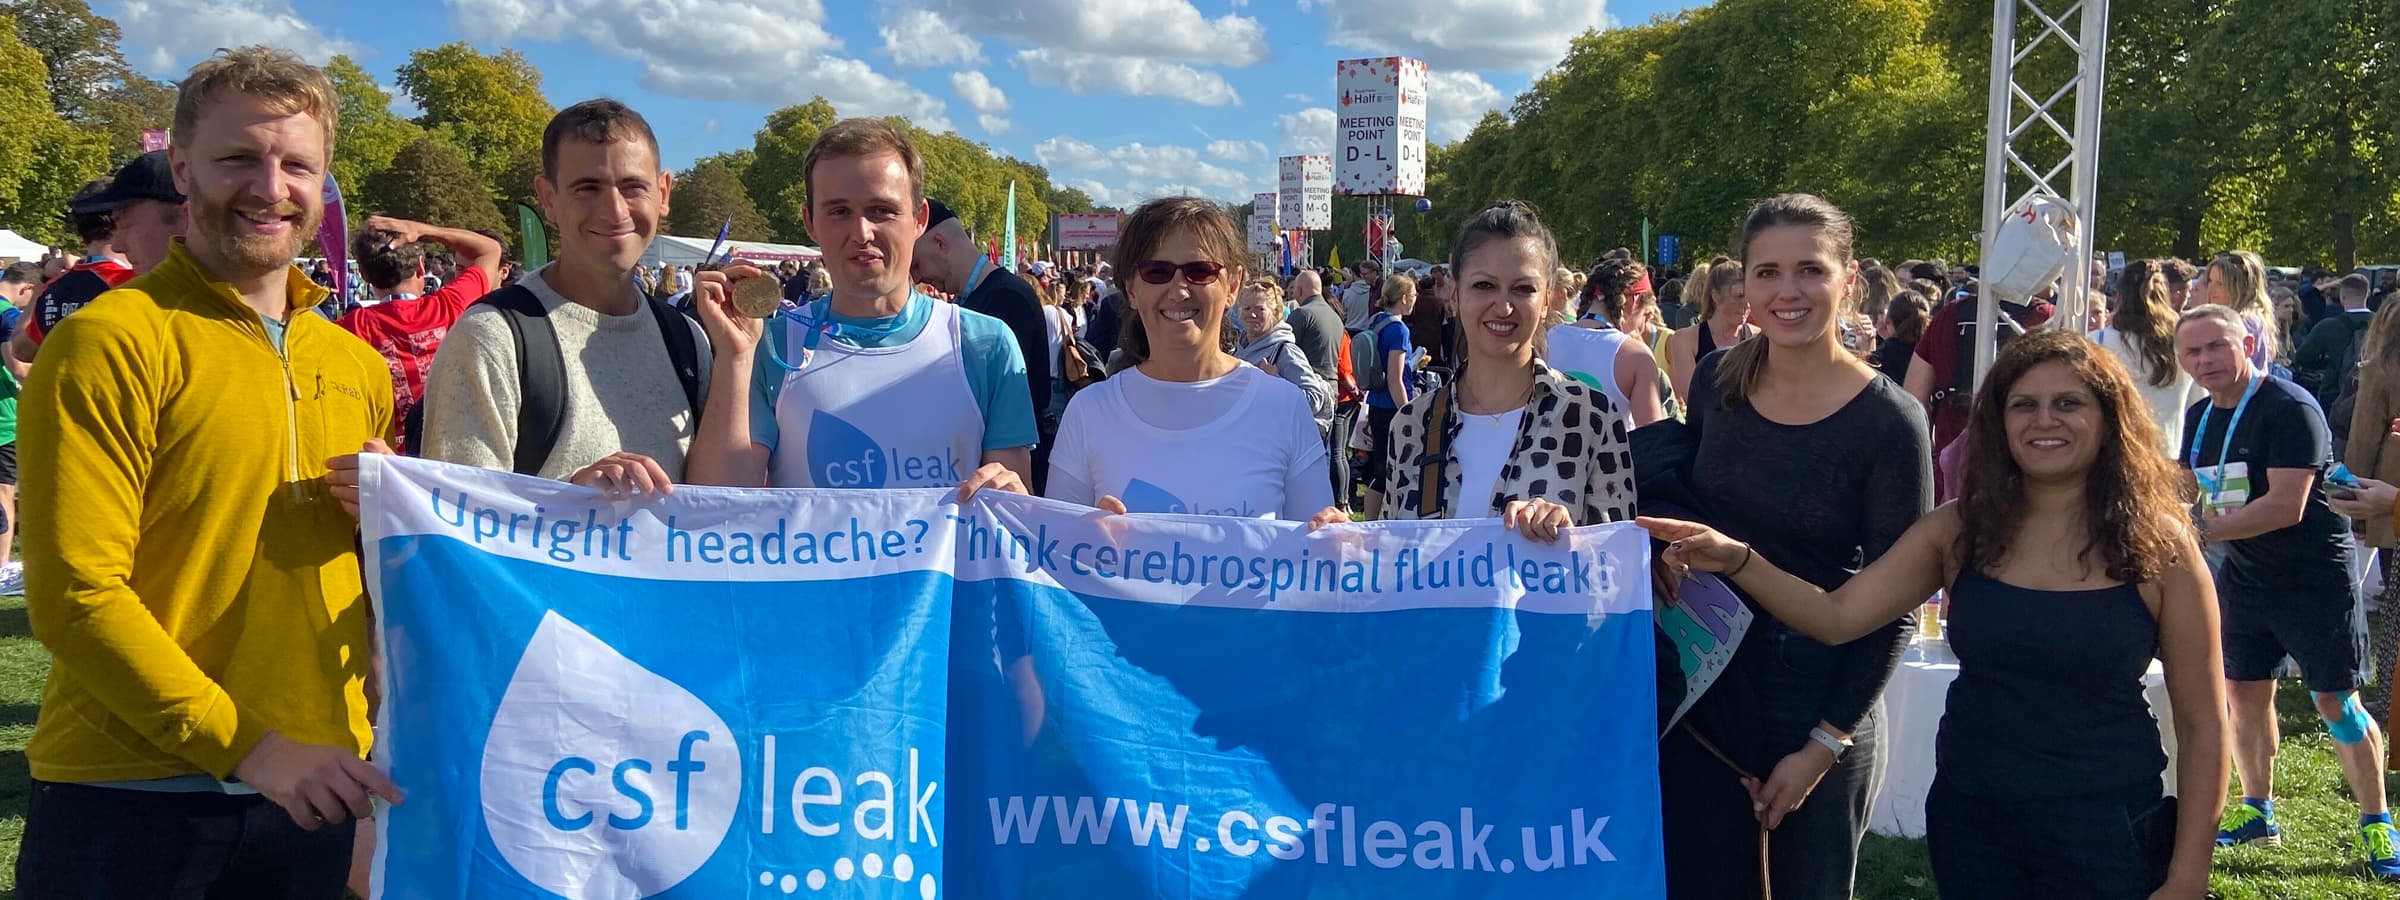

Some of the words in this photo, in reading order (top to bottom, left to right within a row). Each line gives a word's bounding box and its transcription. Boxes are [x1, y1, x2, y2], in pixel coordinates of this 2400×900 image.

[1354, 93, 1376, 104] Half
[1340, 116, 1394, 129] MEETING
[1399, 116, 1424, 130] MEETING
[1348, 129, 1385, 140] POINT
[1403, 129, 1421, 142] POINT
[825, 448, 875, 487] csf
[892, 447, 960, 482] leak
[431, 487, 634, 563] Upright
[666, 514, 929, 565] headache?
[1070, 541, 1382, 602] cerebrospinal
[1395, 542, 1496, 593] fluid
[1507, 543, 1609, 594] leak!
[542, 730, 710, 832] csf
[761, 735, 938, 848] leak
[988, 796, 1618, 875] www.csfleak.uk
